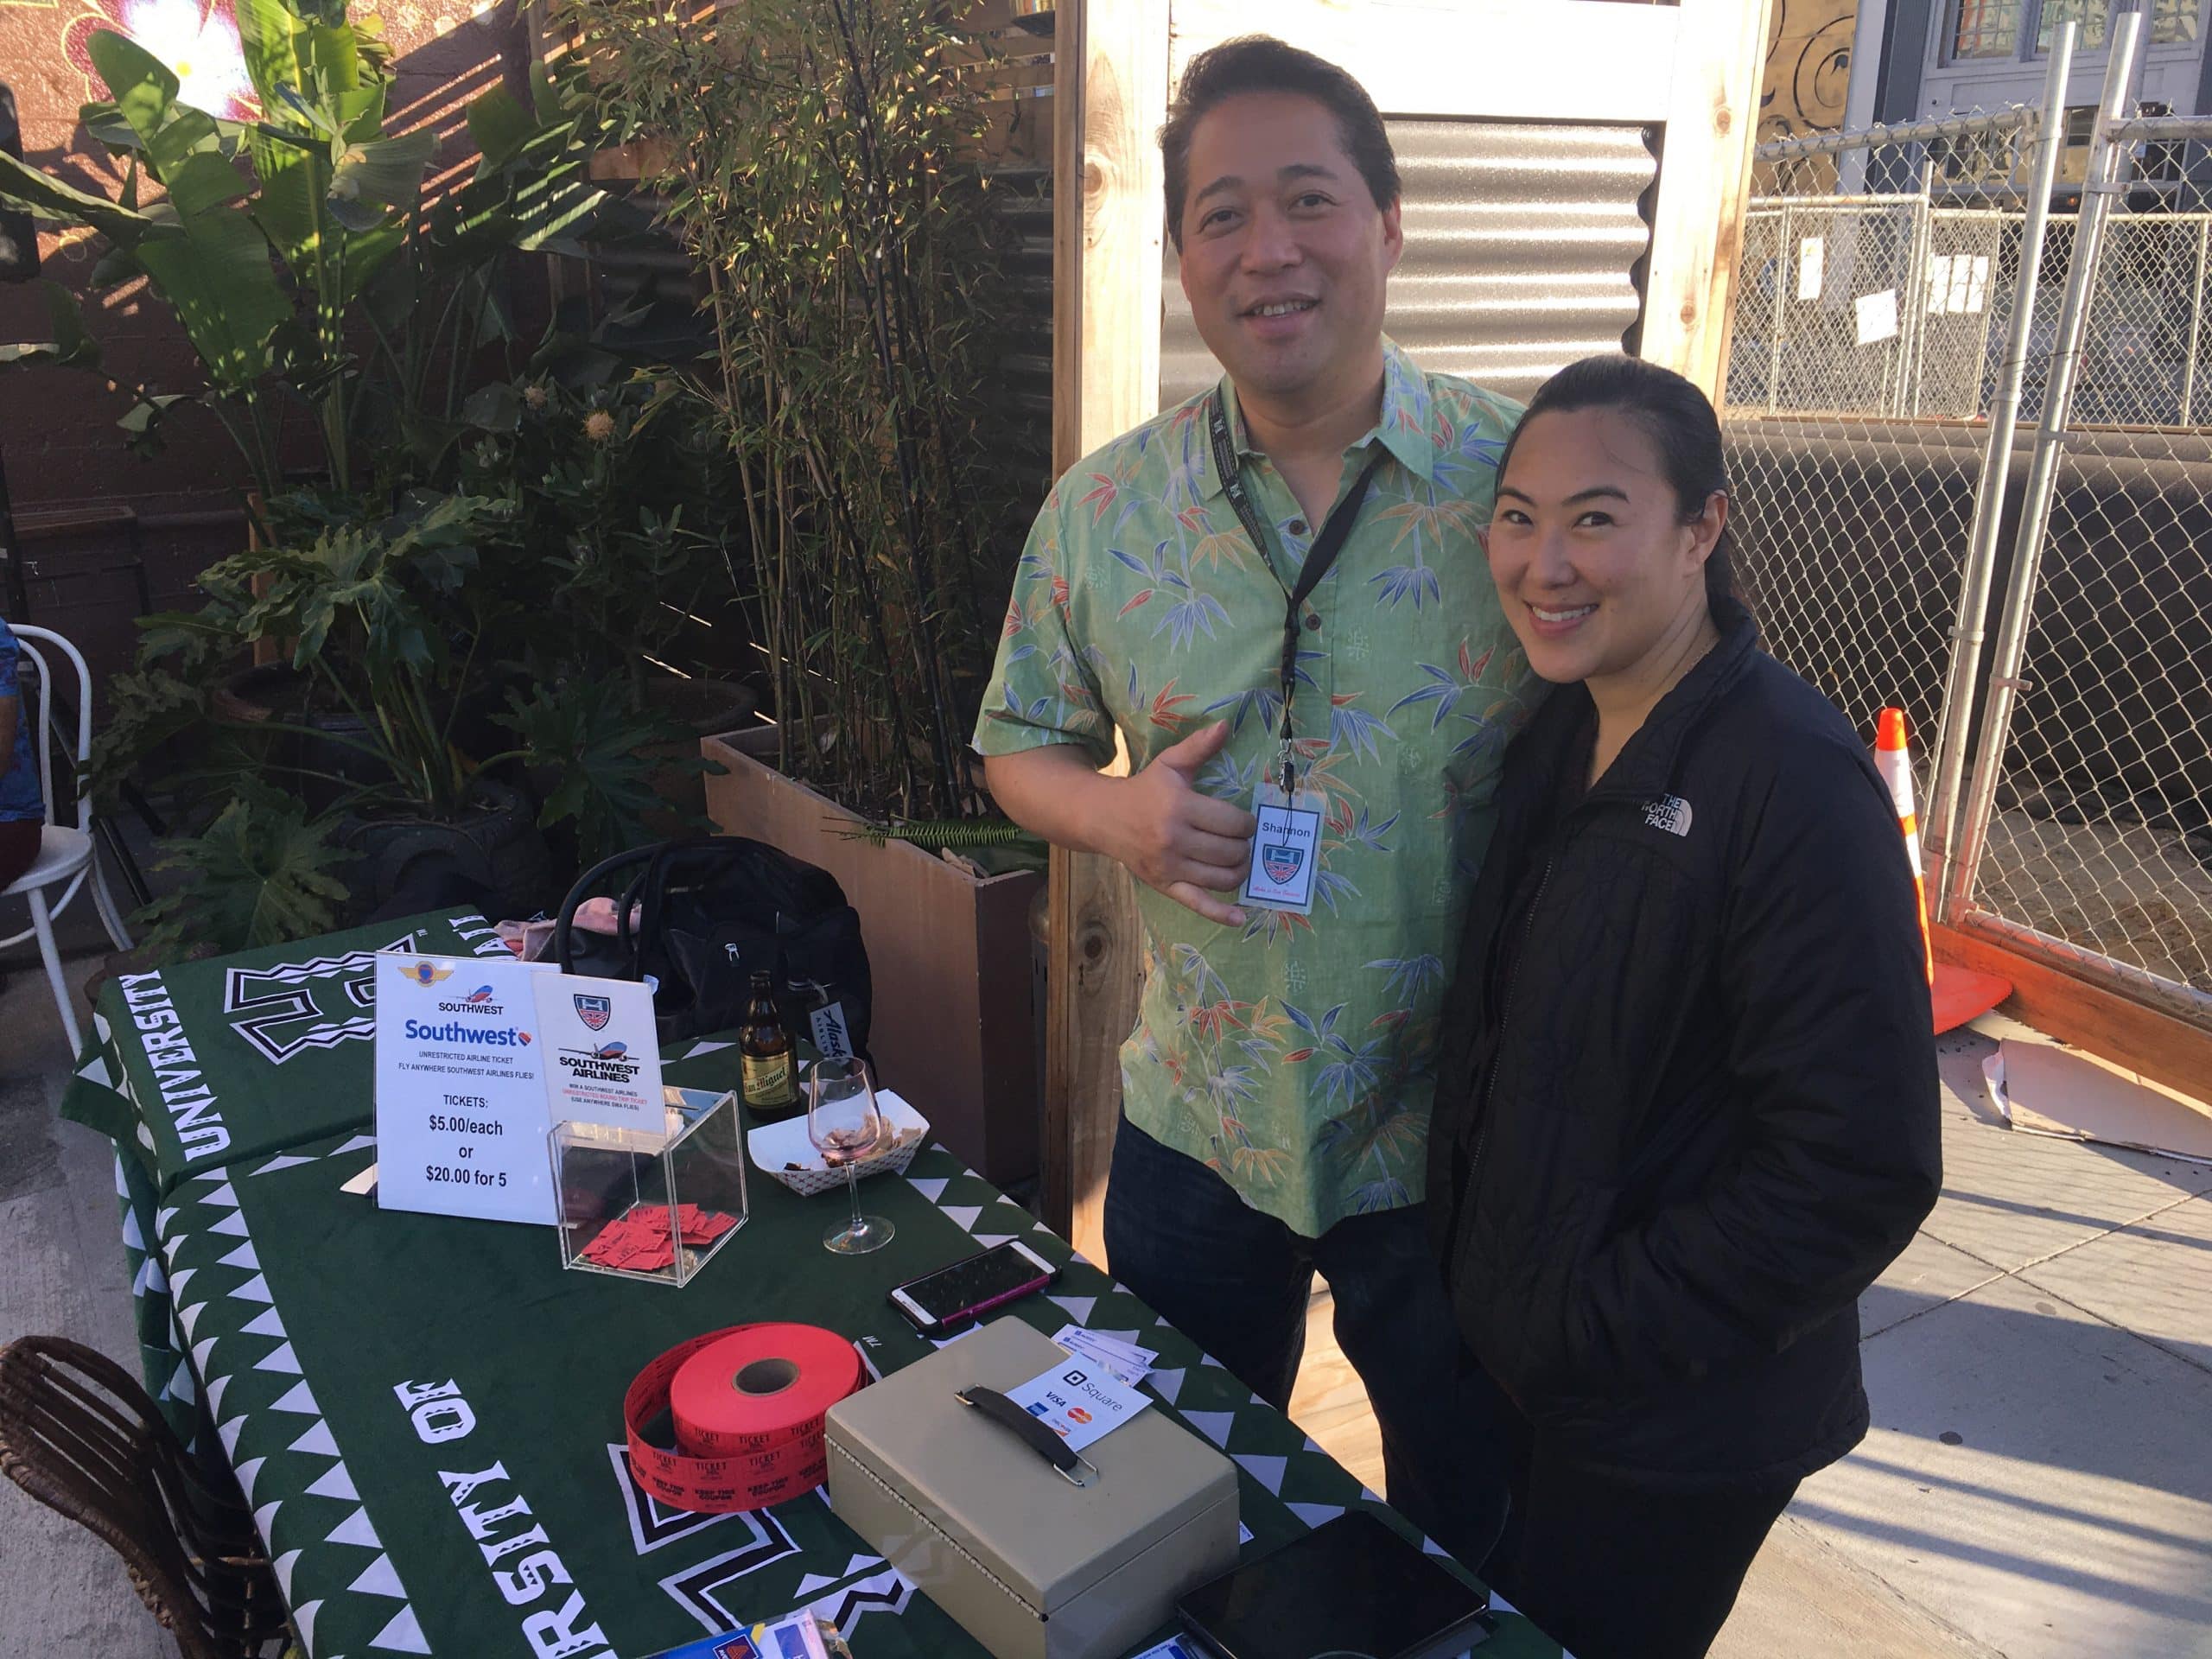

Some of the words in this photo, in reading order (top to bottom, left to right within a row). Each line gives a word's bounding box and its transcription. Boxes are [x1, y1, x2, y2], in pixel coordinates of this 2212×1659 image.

[1662, 793, 1681, 809] THE
[1641, 800, 1678, 821] NORTH
[1262, 822, 1311, 837] Shannon
[1644, 814, 1674, 831] FACE
[438, 1002, 504, 1015] SOUTHWEST
[405, 1019, 517, 1046] Southwest
[118, 969, 232, 1162] UNIVERSITY
[419, 1051, 465, 1061] UNRESTRICTED
[467, 1054, 490, 1063] AIRLINE
[492, 1056, 513, 1065] TICKET
[559, 1057, 640, 1075] SOUTHWEST
[398, 1062, 410, 1071] FLY
[411, 1065, 446, 1073] ANYWHERE
[447, 1066, 484, 1076] SOUTHWEST
[486, 1069, 514, 1078] AIRLINES
[572, 1068, 630, 1084] AIRLINES
[757, 1066, 786, 1090] Miguel
[443, 1094, 488, 1109] TICKETS:
[429, 1114, 503, 1135] $5.00/each
[459, 1146, 474, 1159] or
[426, 1165, 470, 1184] $20.00
[474, 1170, 494, 1185] for
[499, 1172, 506, 1187] 5
[1046, 1391, 1067, 1408] VISA
[1081, 1382, 1122, 1412] Square
[392, 1377, 476, 1444] OF
[791, 1416, 819, 1435] TICKET
[739, 1433, 770, 1444] TICKET
[696, 1461, 727, 1471] TICKET
[749, 1452, 780, 1466] TICKET
